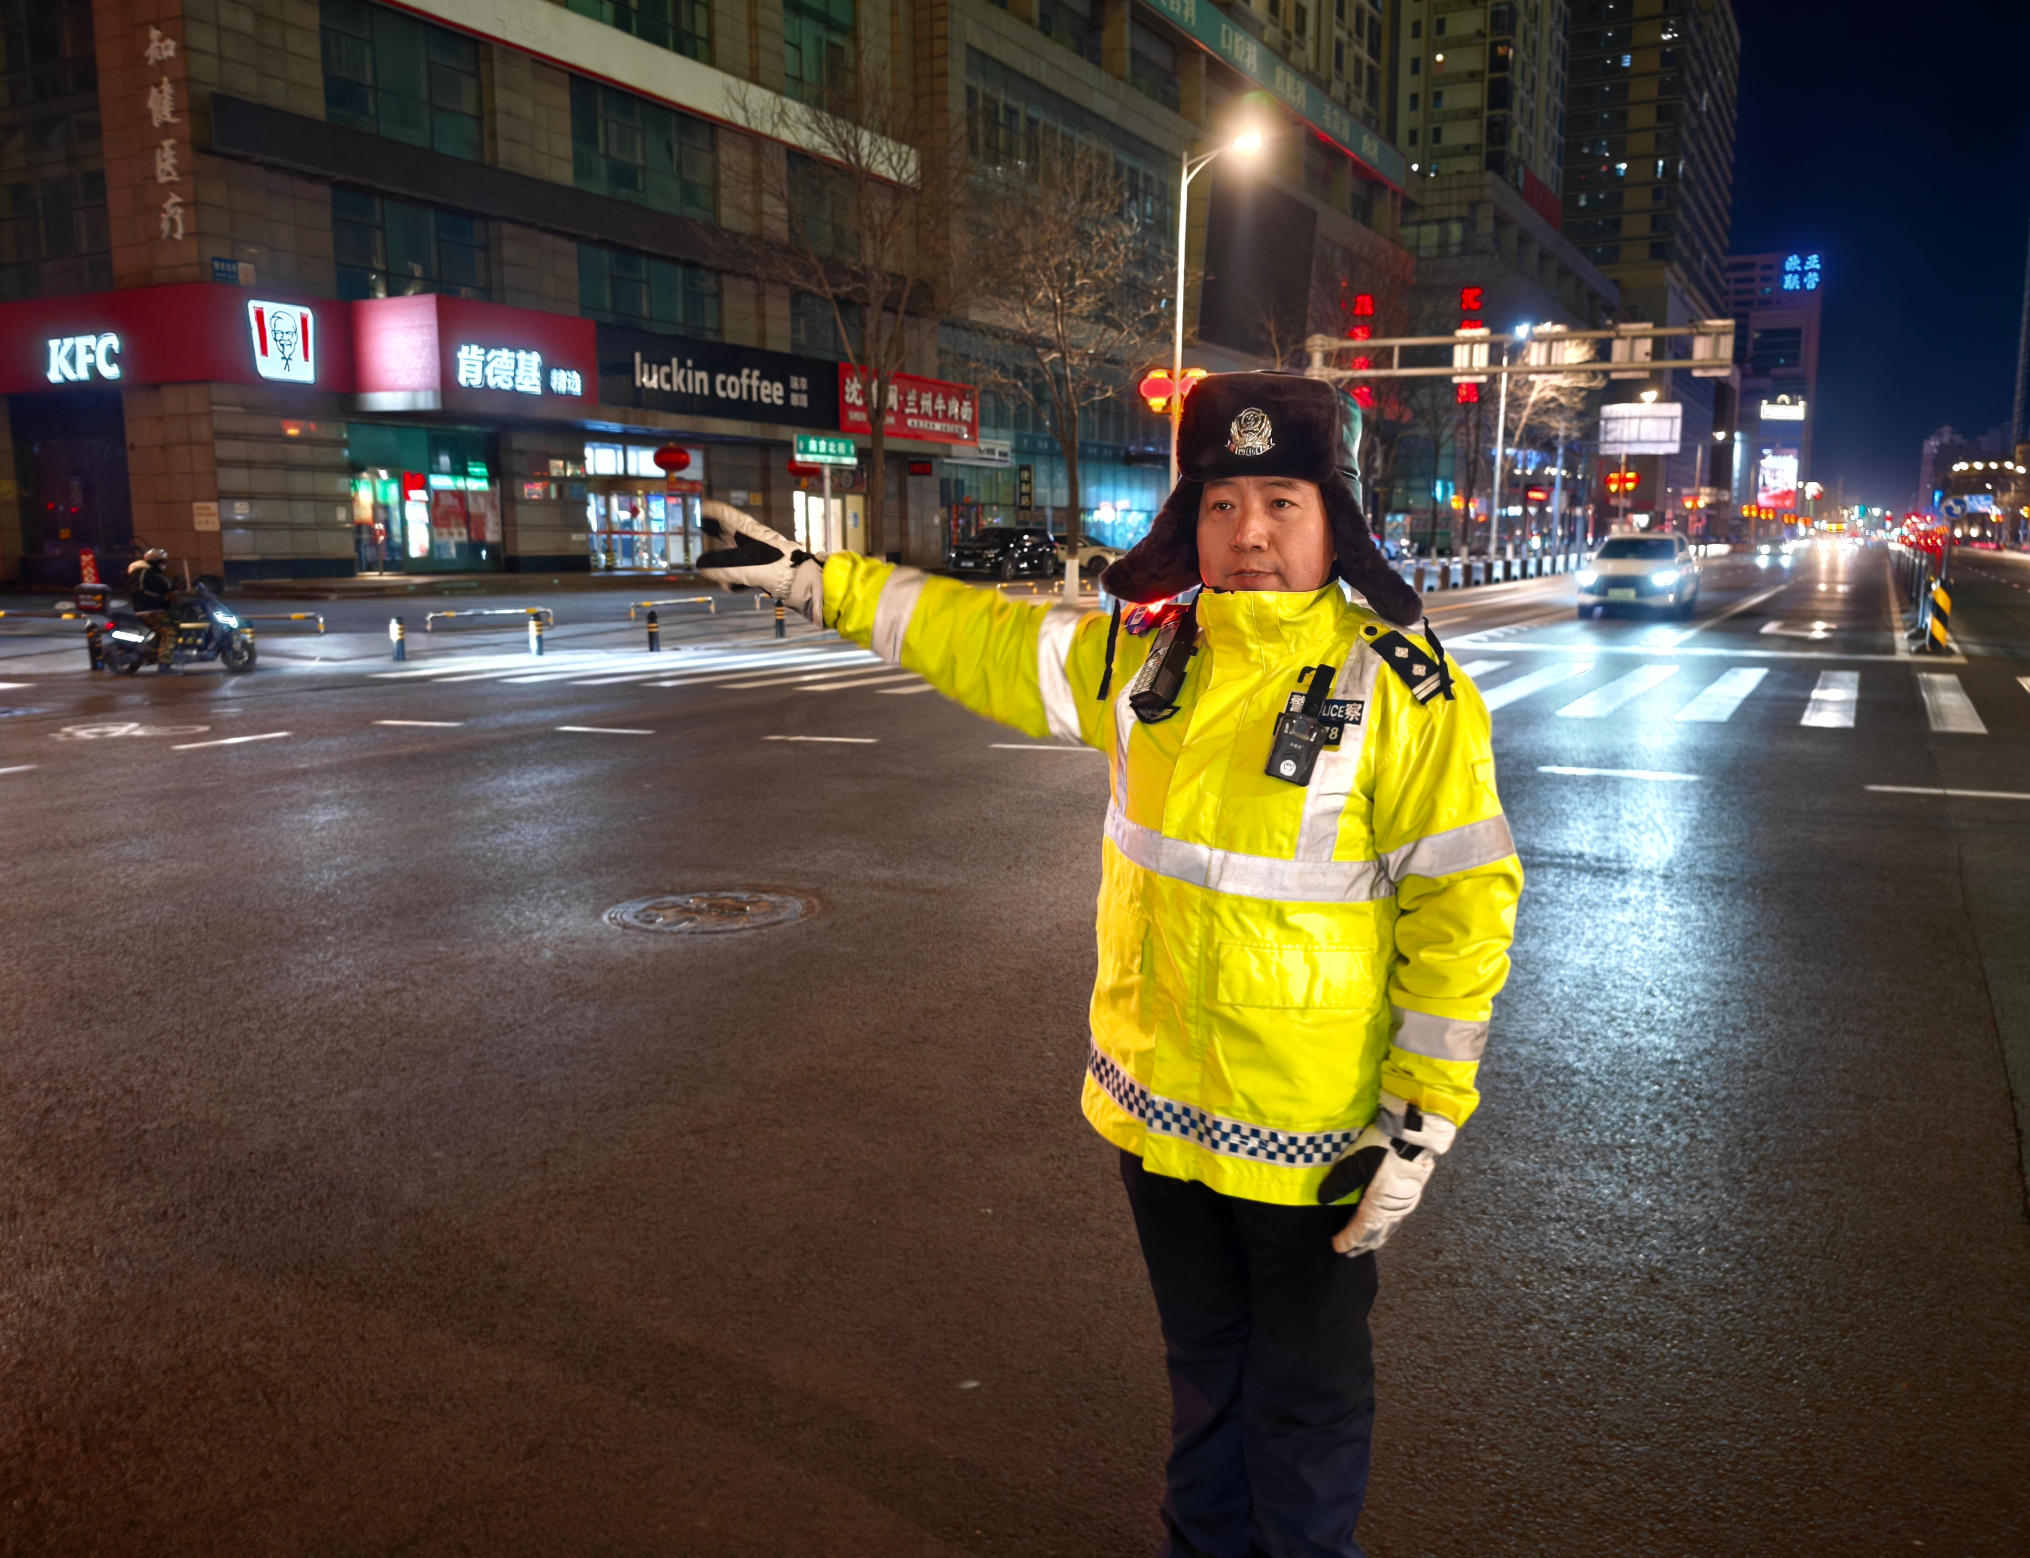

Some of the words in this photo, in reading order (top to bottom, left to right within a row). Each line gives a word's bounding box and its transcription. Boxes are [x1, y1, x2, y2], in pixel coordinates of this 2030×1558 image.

[46, 332, 121, 384] KFC
[456, 343, 542, 395] 肯德基
[634, 351, 709, 396] luckin
[715, 367, 784, 406] coffee
[1320, 704, 1345, 718] LICE
